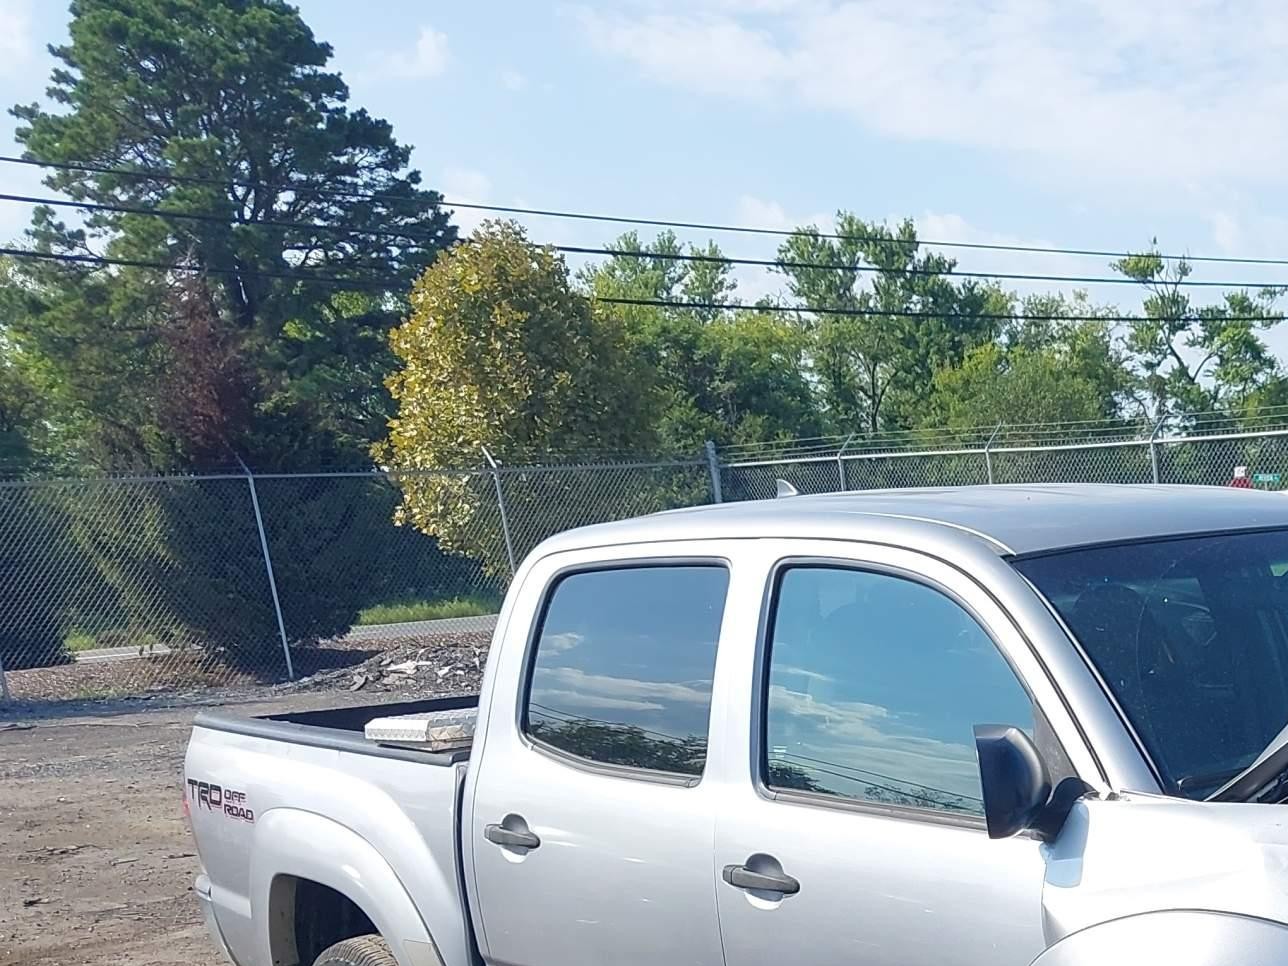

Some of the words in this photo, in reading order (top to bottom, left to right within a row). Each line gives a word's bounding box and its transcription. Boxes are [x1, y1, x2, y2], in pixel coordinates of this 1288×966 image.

[187, 778, 222, 811] TRD
[224, 789, 246, 802] OFF
[224, 804, 254, 821] ROAD
